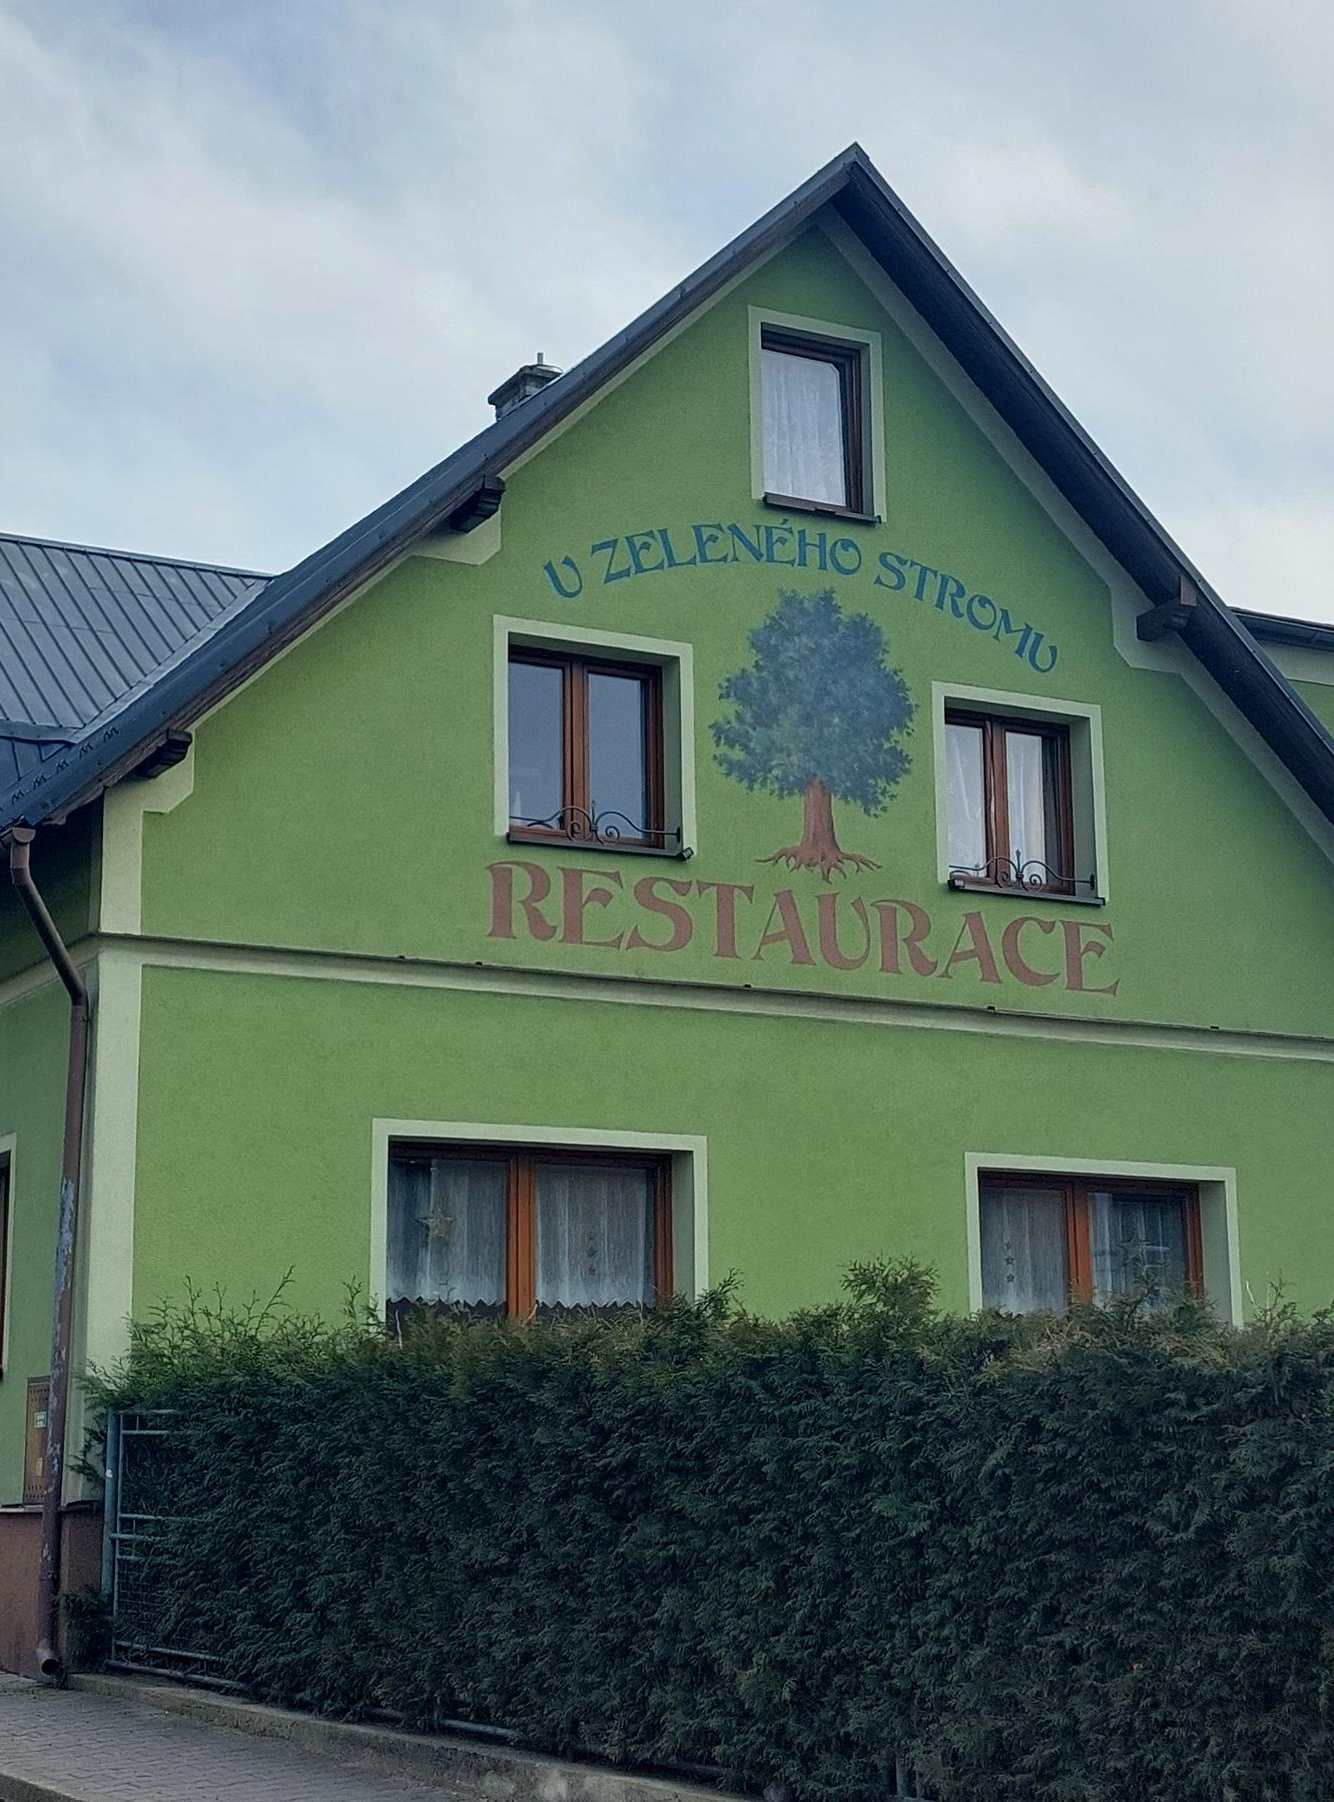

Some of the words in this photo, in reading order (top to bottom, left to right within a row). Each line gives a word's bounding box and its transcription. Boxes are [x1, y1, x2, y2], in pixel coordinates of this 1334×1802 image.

[543, 555, 584, 599] U
[591, 518, 863, 584] ZELENÉHO
[874, 551, 1059, 674] STROMU
[486, 860, 1120, 997] RESTAURACE
